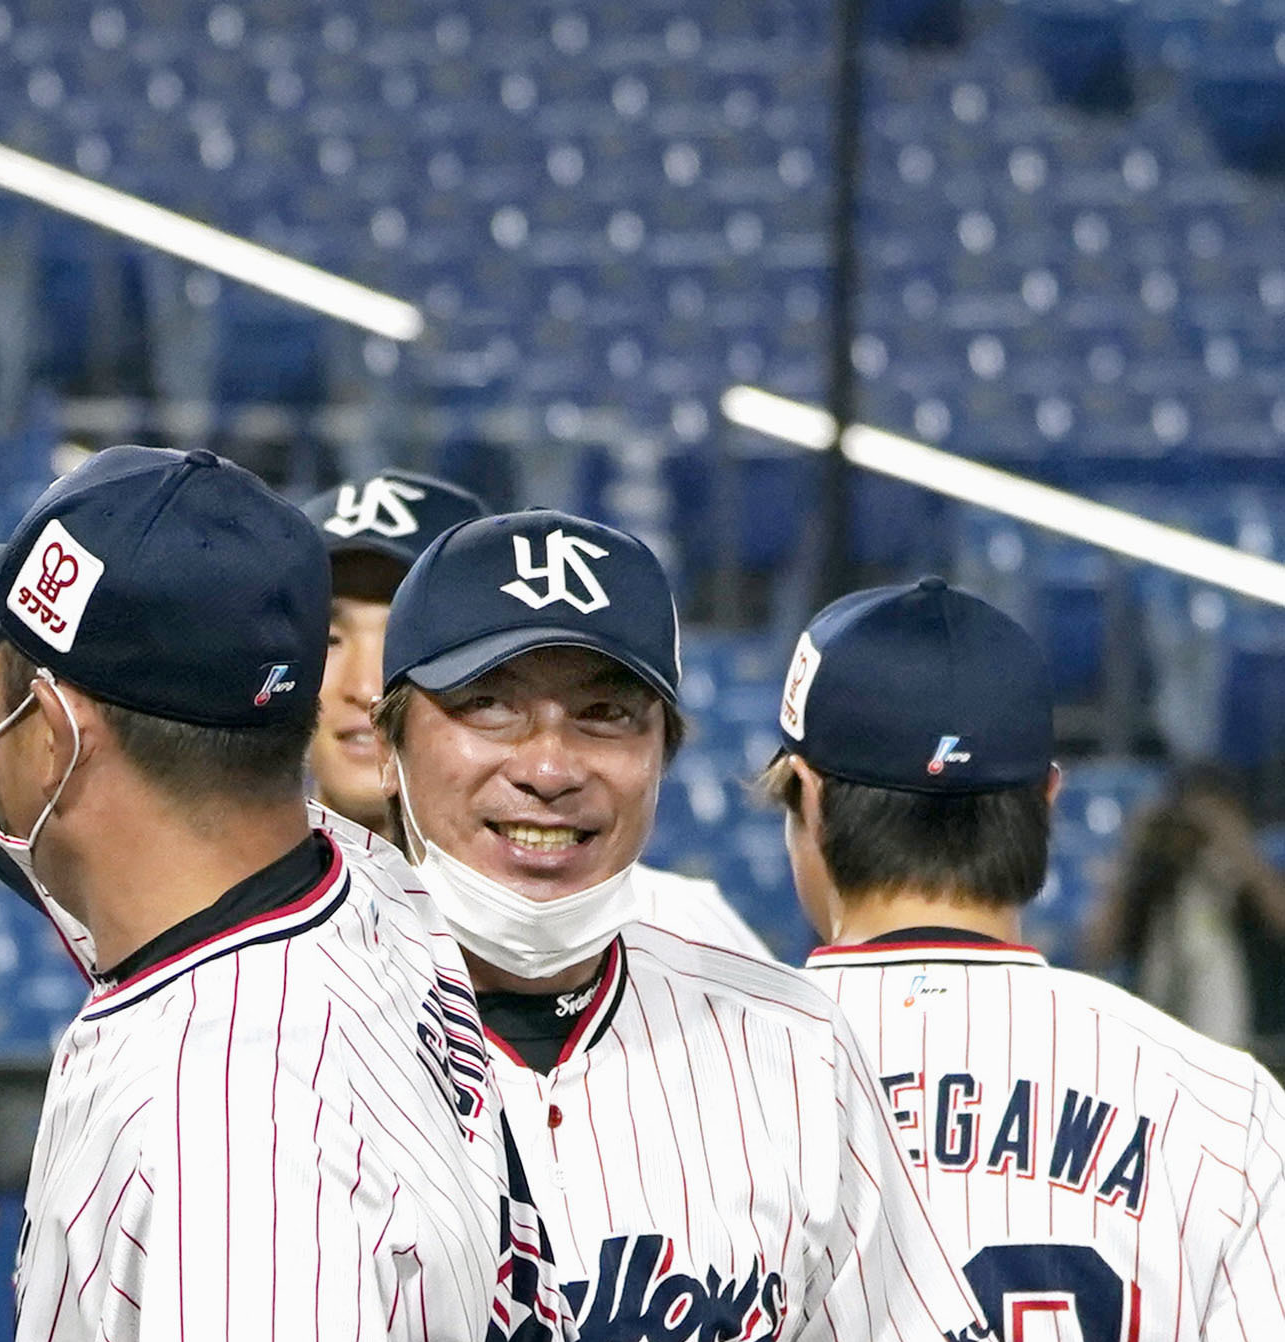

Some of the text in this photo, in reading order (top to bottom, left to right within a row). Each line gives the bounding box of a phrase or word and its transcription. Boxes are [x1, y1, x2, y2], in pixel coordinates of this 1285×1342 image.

[18, 586, 68, 634] タフマン
[878, 1068, 1156, 1222] EGAWA
